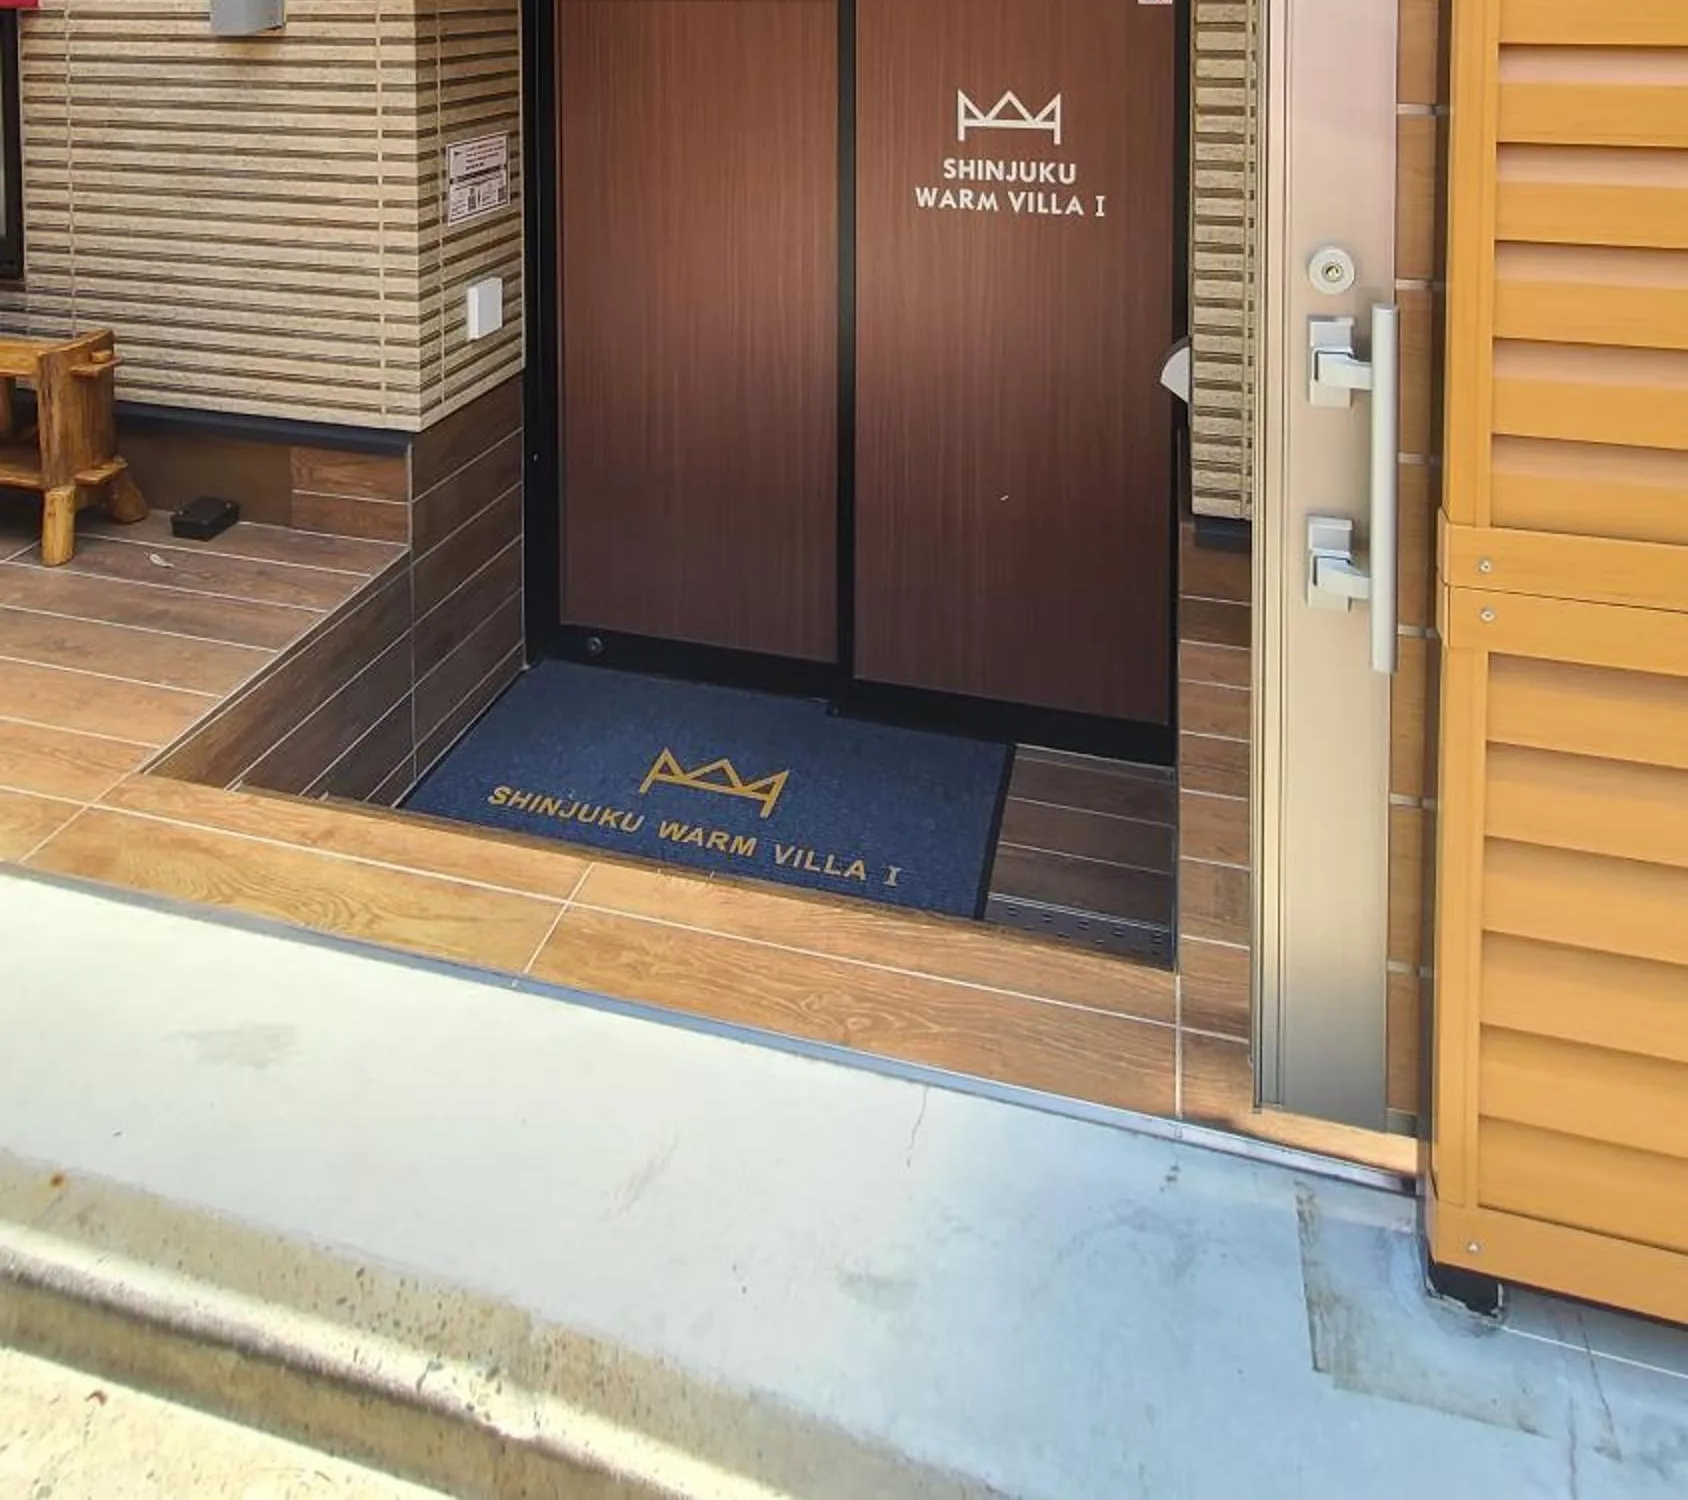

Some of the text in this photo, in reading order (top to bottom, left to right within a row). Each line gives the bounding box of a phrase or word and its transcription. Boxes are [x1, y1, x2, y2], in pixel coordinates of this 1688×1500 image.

[943, 157, 1077, 185] SHINJUKU
[914, 186, 1105, 217] WARM VILLA I
[487, 784, 903, 889] SHINJUKU WARM VILLA I
